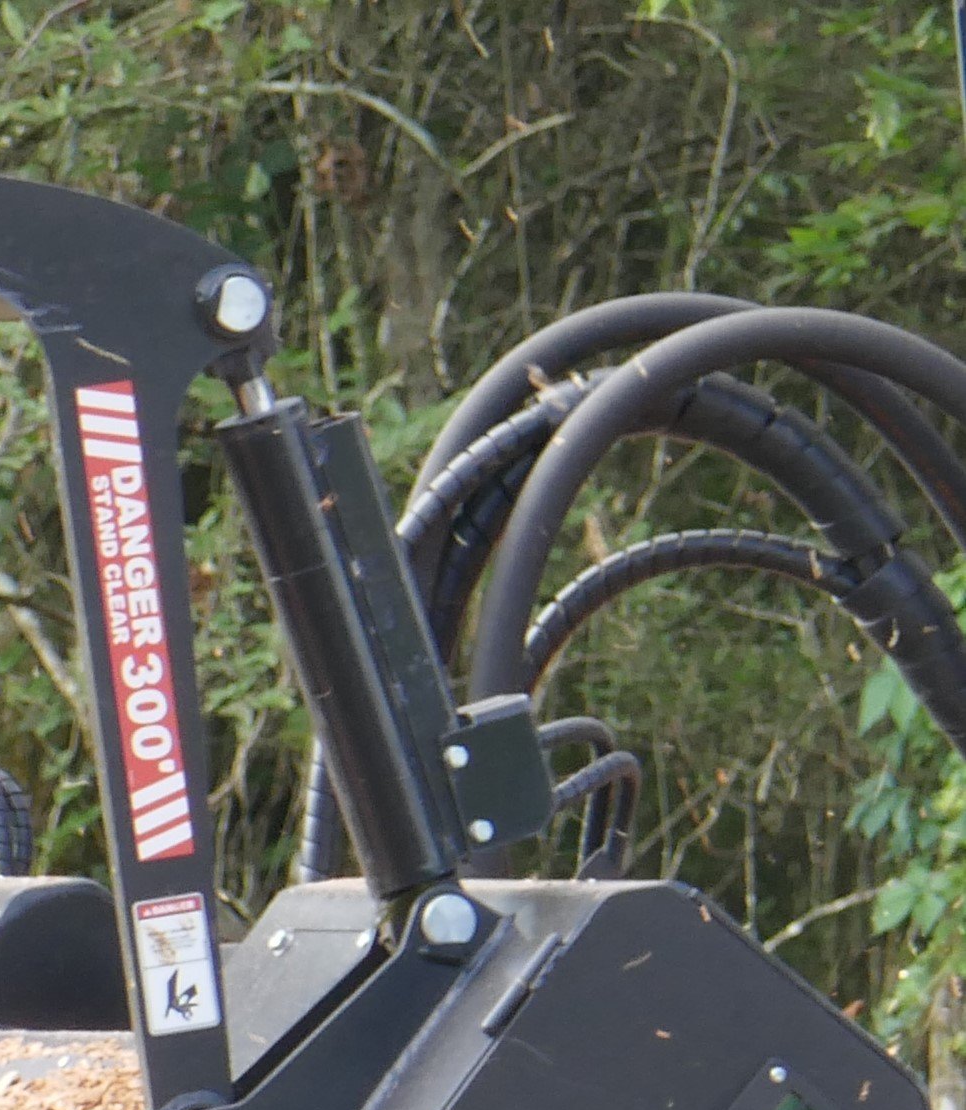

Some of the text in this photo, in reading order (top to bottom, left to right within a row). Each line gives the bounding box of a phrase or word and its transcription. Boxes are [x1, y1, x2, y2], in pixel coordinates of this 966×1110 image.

[91, 474, 130, 645] STAND CLEAR
[111, 465, 164, 648] DANGER
